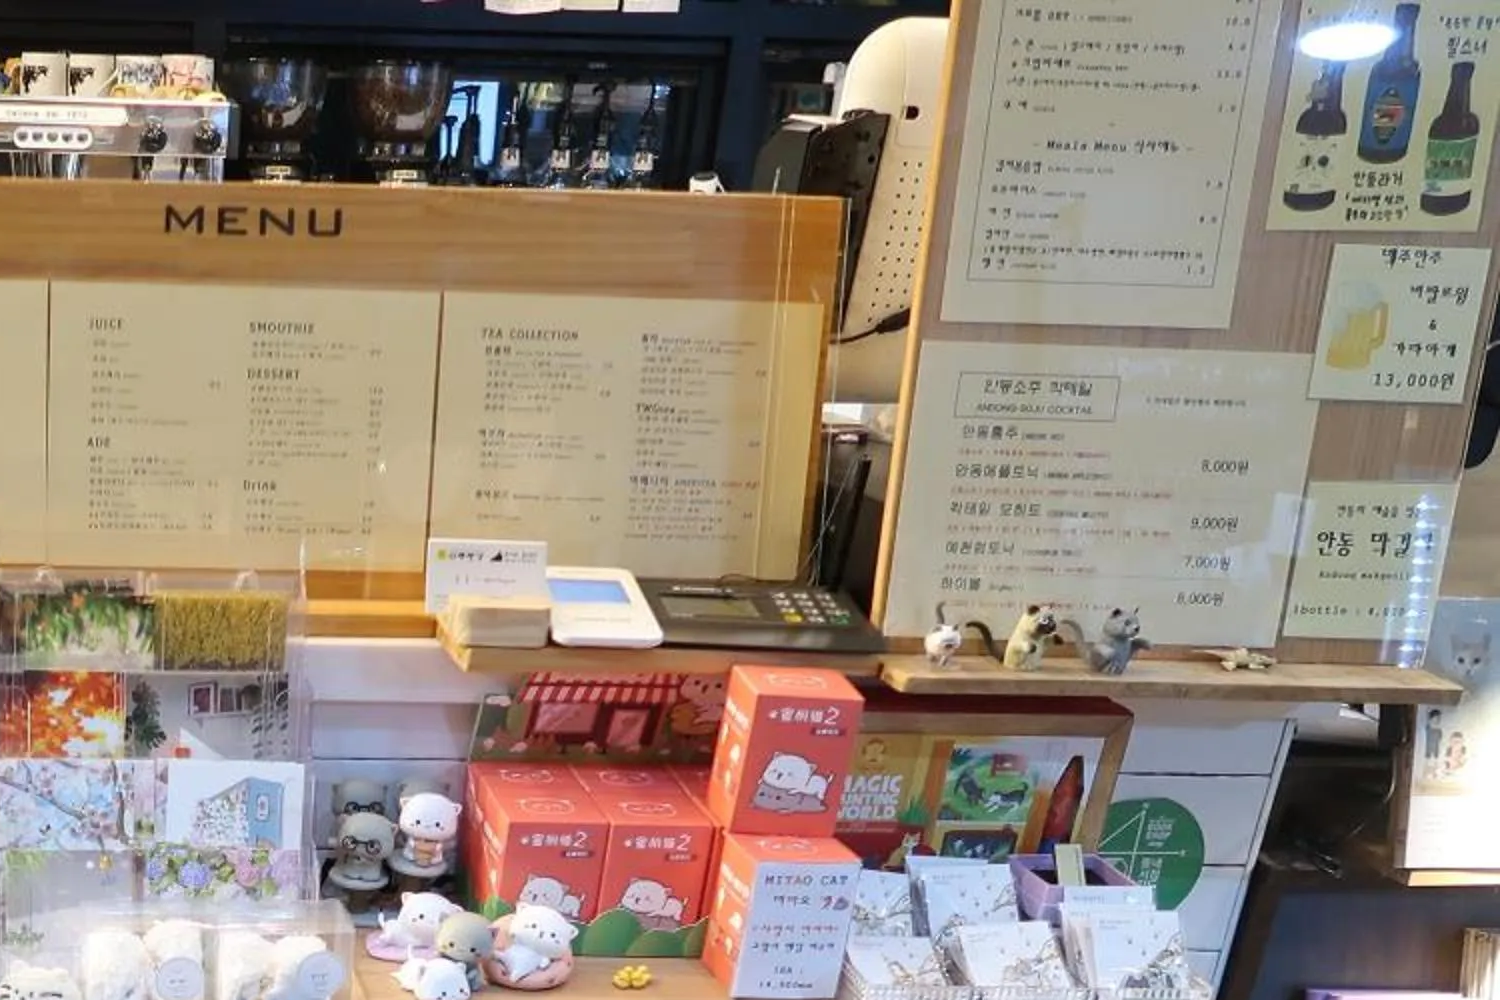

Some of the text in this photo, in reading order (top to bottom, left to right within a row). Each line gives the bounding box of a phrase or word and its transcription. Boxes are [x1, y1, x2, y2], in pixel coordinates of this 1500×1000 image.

[1094, 141, 1126, 150] Menu
[163, 205, 344, 237] MENU
[88, 318, 124, 331] JUICE
[249, 322, 315, 335] SMOOTHIE
[481, 328, 579, 341] TEA COLLECTION
[247, 368, 300, 381] DESSERT
[1316, 531, 1354, 557] 안동
[764, 875, 849, 886] MITAO CAT
